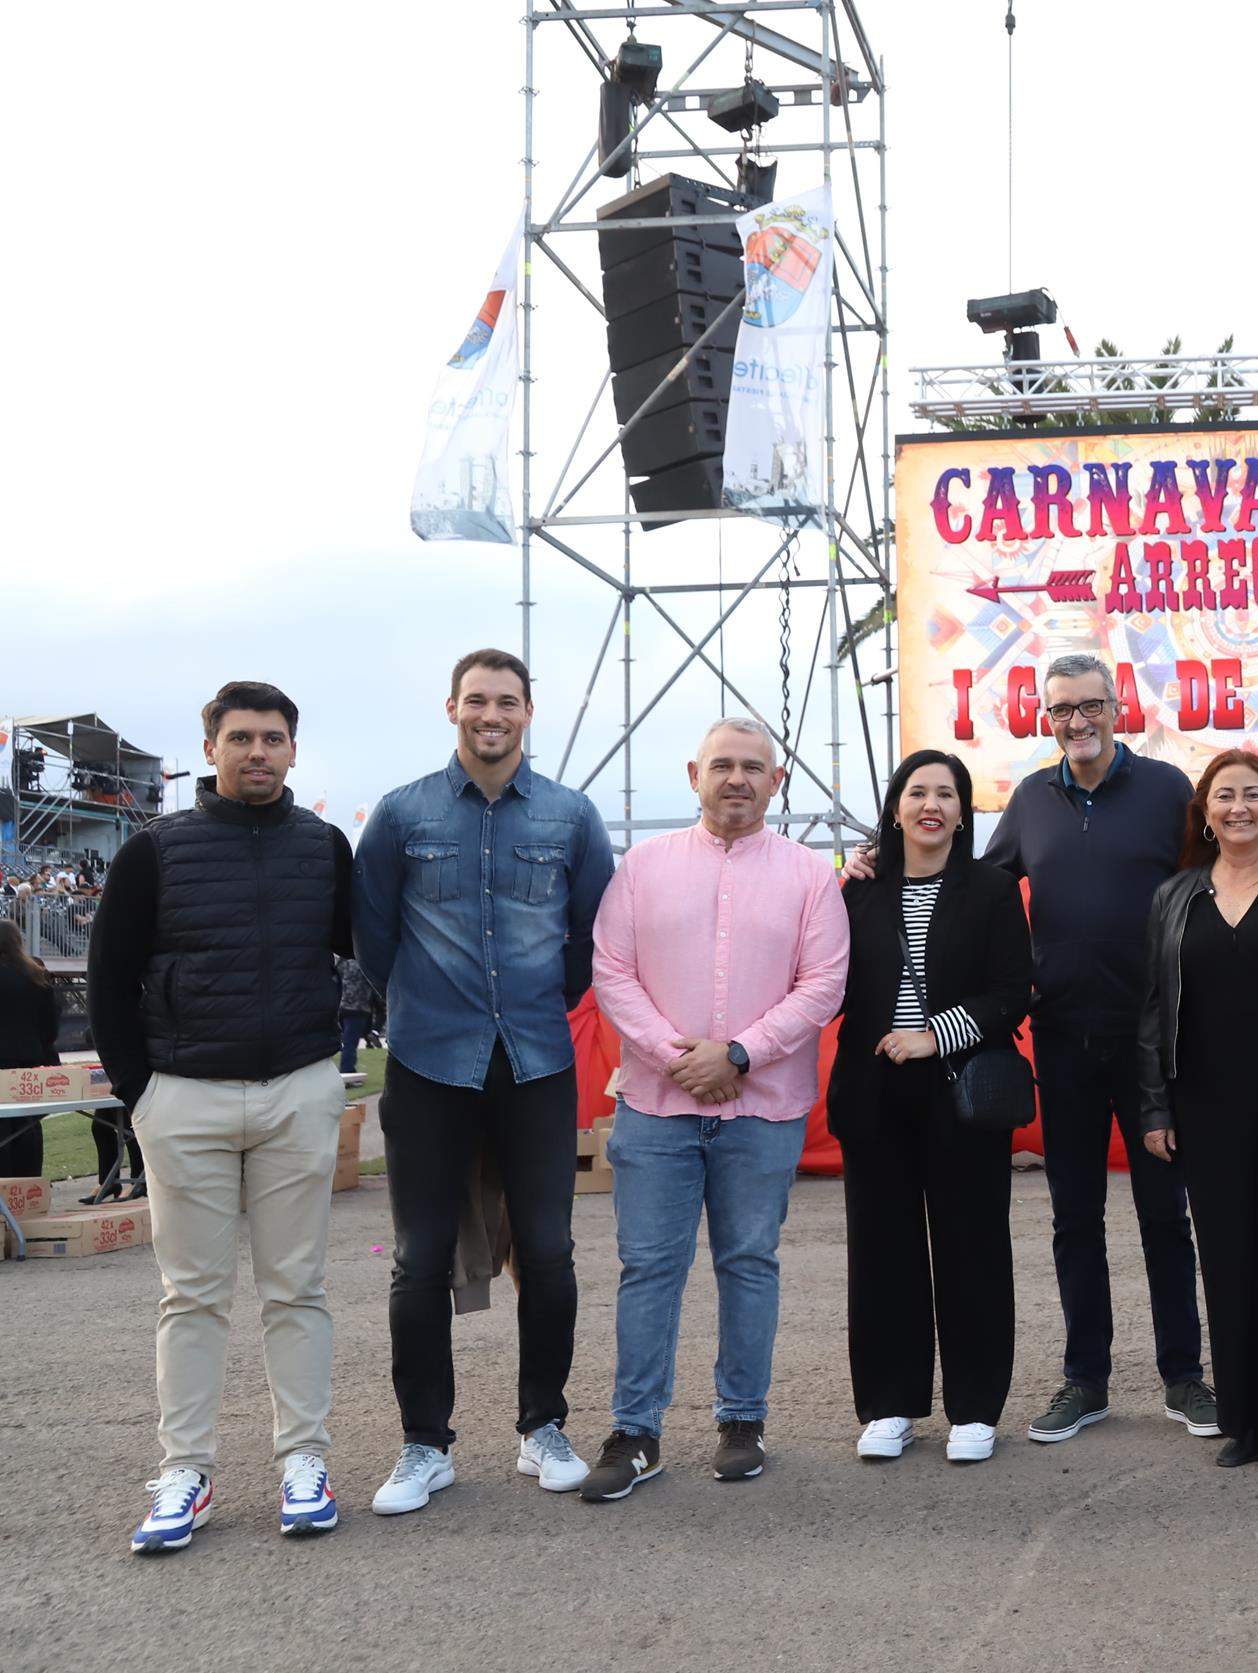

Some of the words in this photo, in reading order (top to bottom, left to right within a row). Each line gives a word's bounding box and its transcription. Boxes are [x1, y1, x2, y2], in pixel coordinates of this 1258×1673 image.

[953, 668, 974, 740] I
[1007, 662, 1145, 739] GA
[1177, 658, 1245, 731] DE
